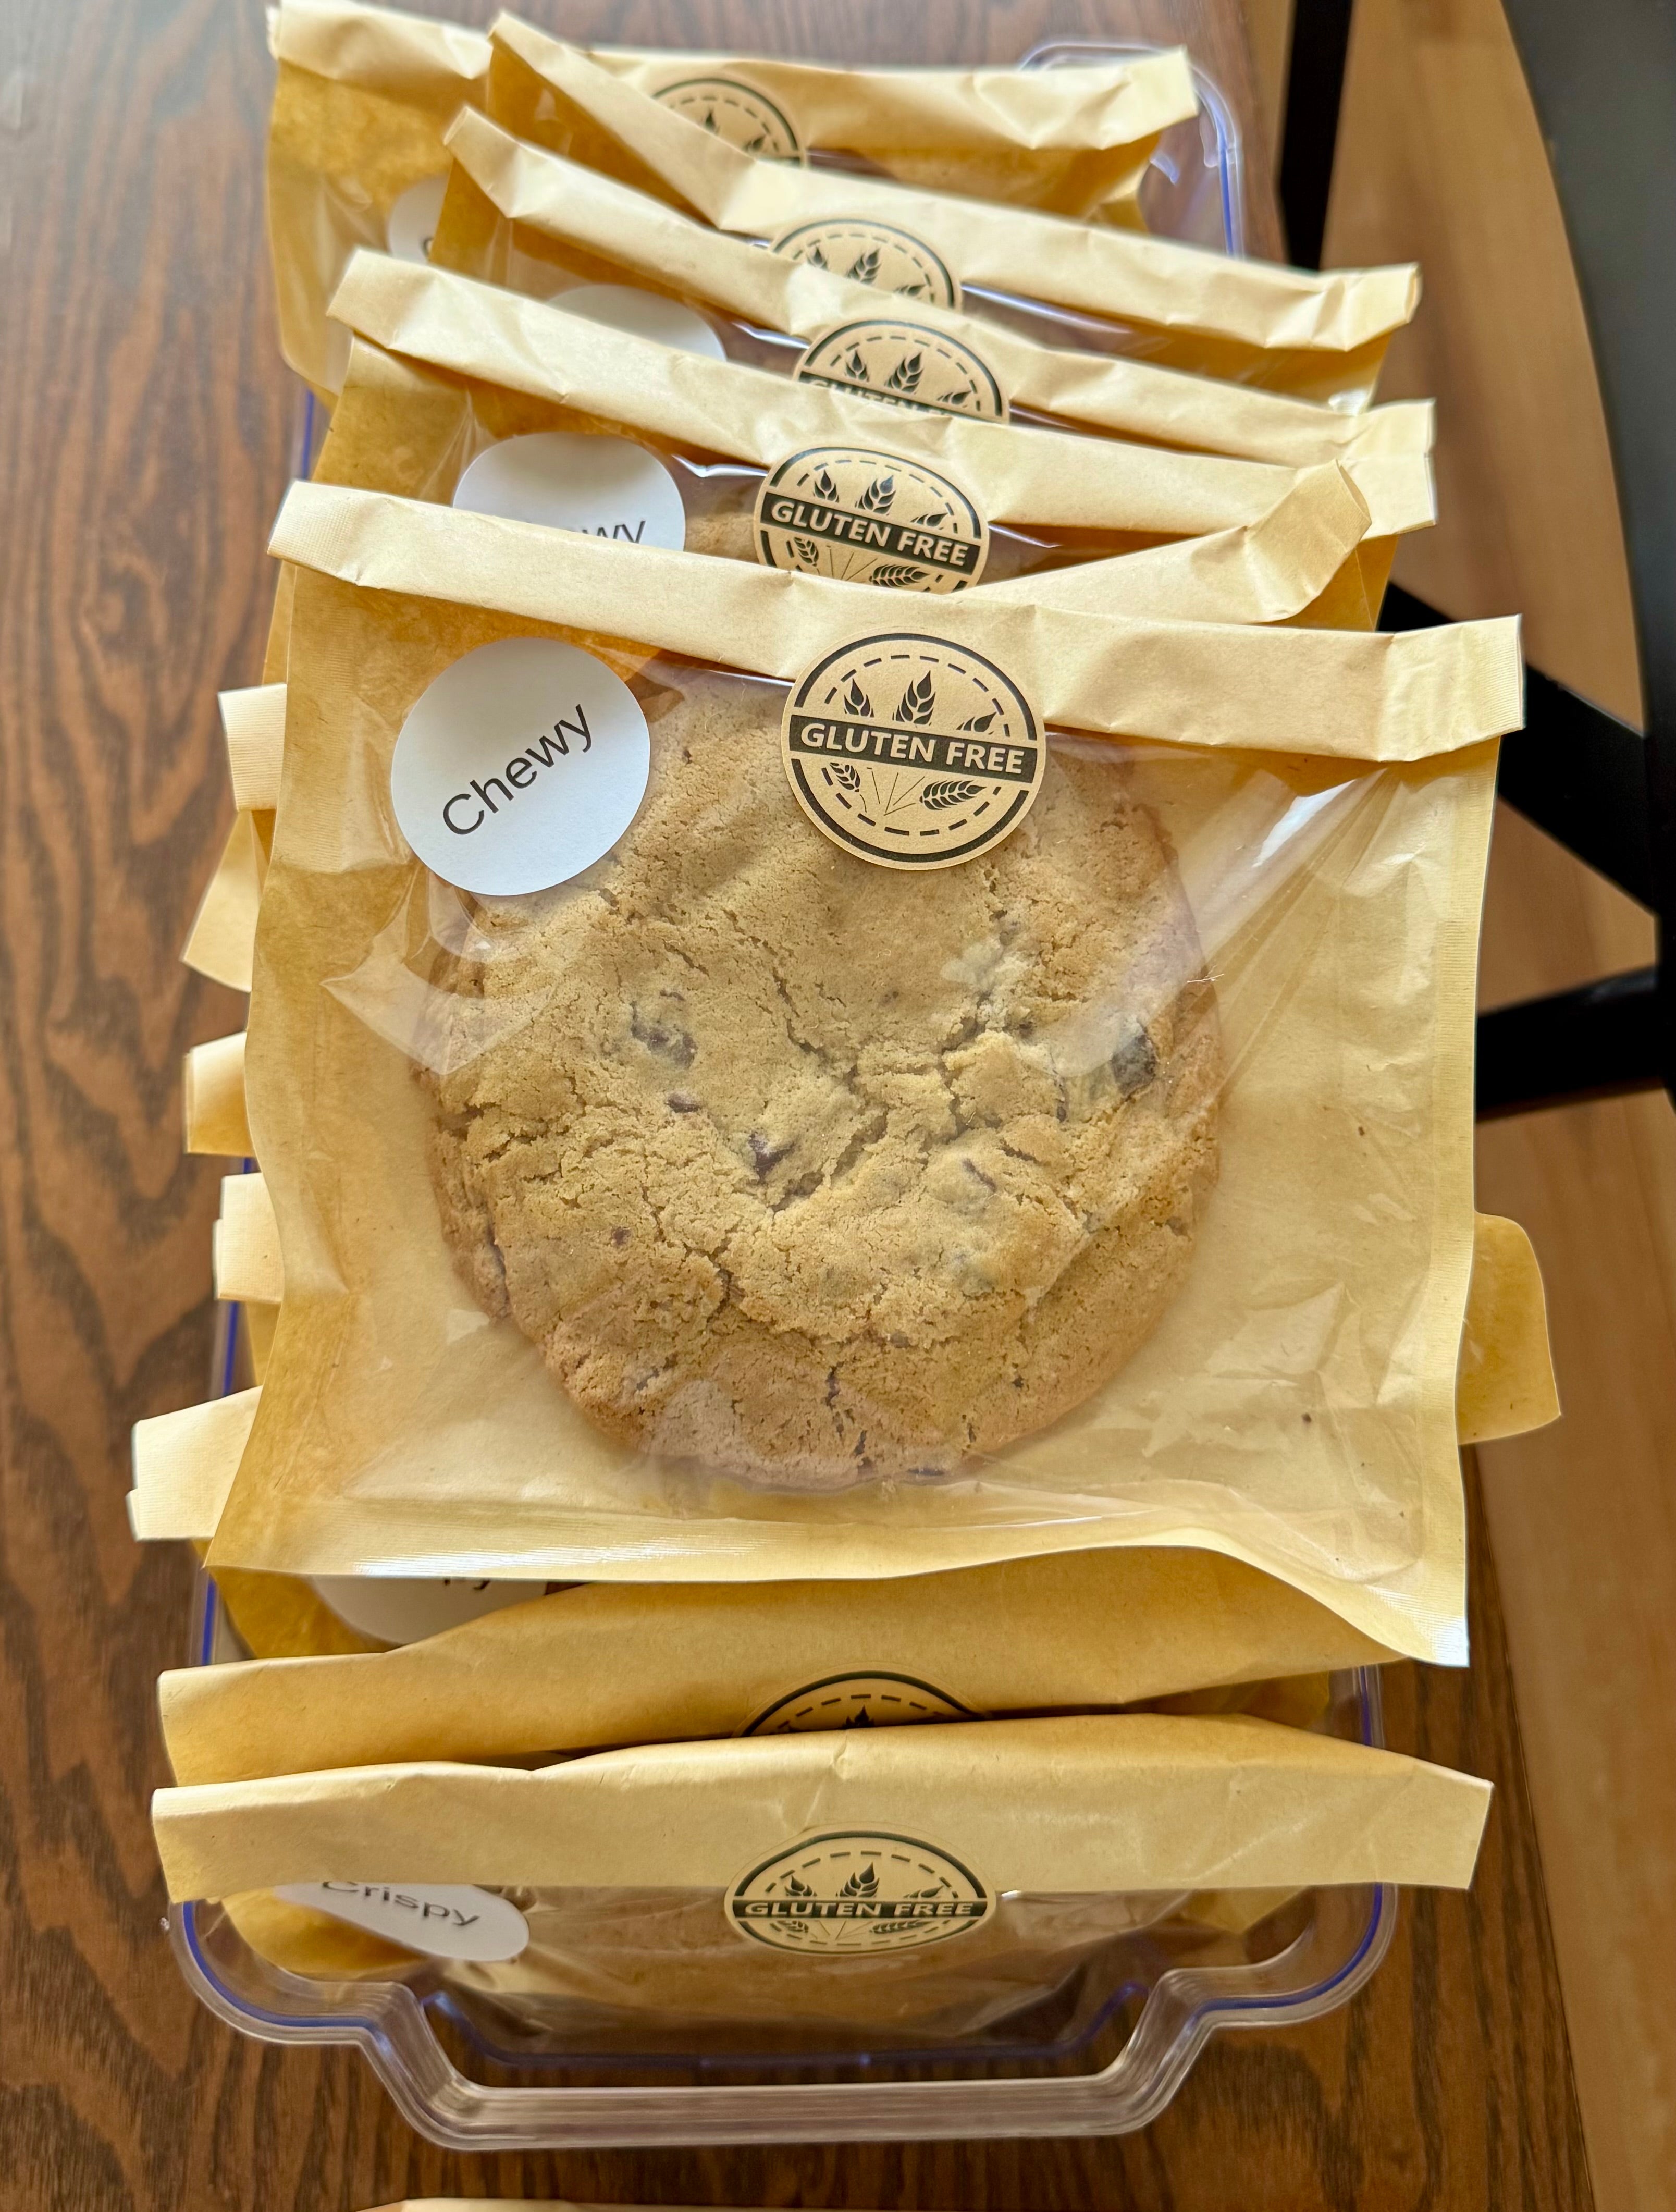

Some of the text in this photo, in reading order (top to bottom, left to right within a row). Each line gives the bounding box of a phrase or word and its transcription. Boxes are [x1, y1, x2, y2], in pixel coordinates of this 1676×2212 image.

[771, 501, 969, 566] GLUTEN FREE
[443, 704, 591, 835] Chewy
[800, 723, 1025, 774] GLUTEN FREE
[322, 1881, 480, 1926] Crispy
[745, 1902, 973, 1916] GLUTEN FREE
